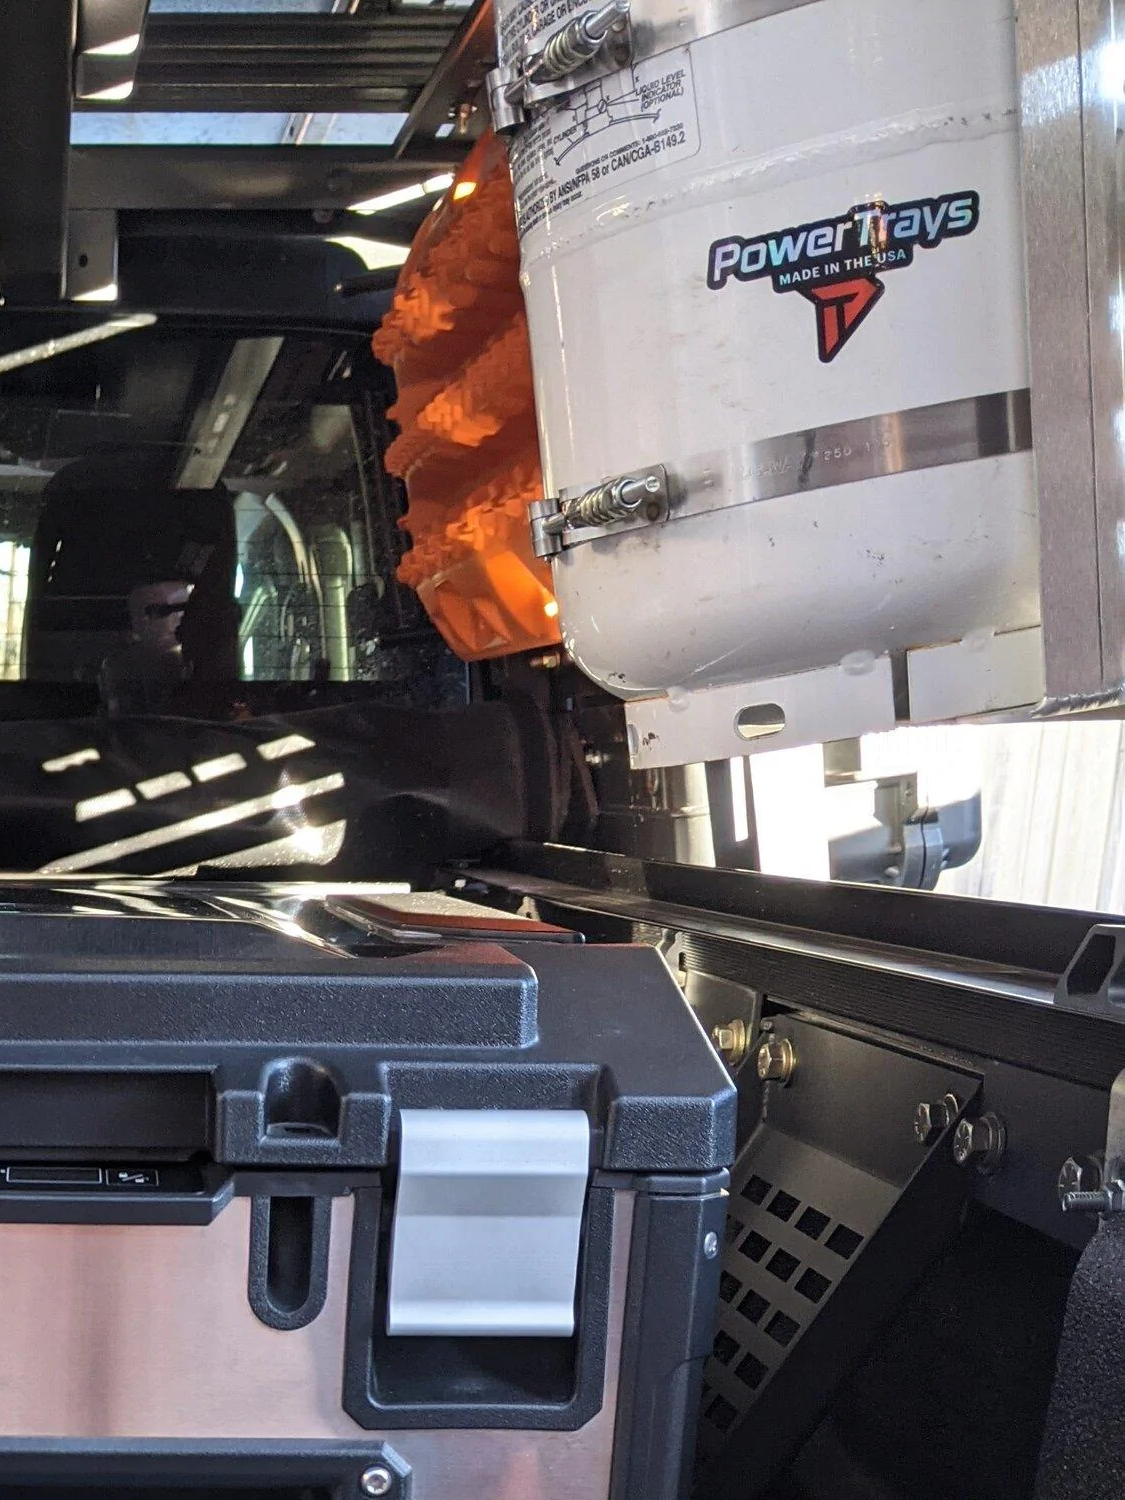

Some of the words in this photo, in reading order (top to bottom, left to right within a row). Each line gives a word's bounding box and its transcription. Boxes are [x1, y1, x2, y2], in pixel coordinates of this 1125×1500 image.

[635, 80, 661, 96] LIQUID
[662, 69, 687, 85] LEVEL
[641, 80, 682, 103] INDICATOR
[640, 87, 685, 113] (OPTIONAL)
[591, 167, 601, 181] 58
[601, 165, 610, 177] or
[610, 131, 687, 172] CAN/CGA-B149.2
[712, 197, 974, 282] PowerTrays
[779, 266, 821, 286] MADE
[824, 262, 841, 276] IN
[844, 256, 872, 272] THE
[876, 248, 907, 266] USA
